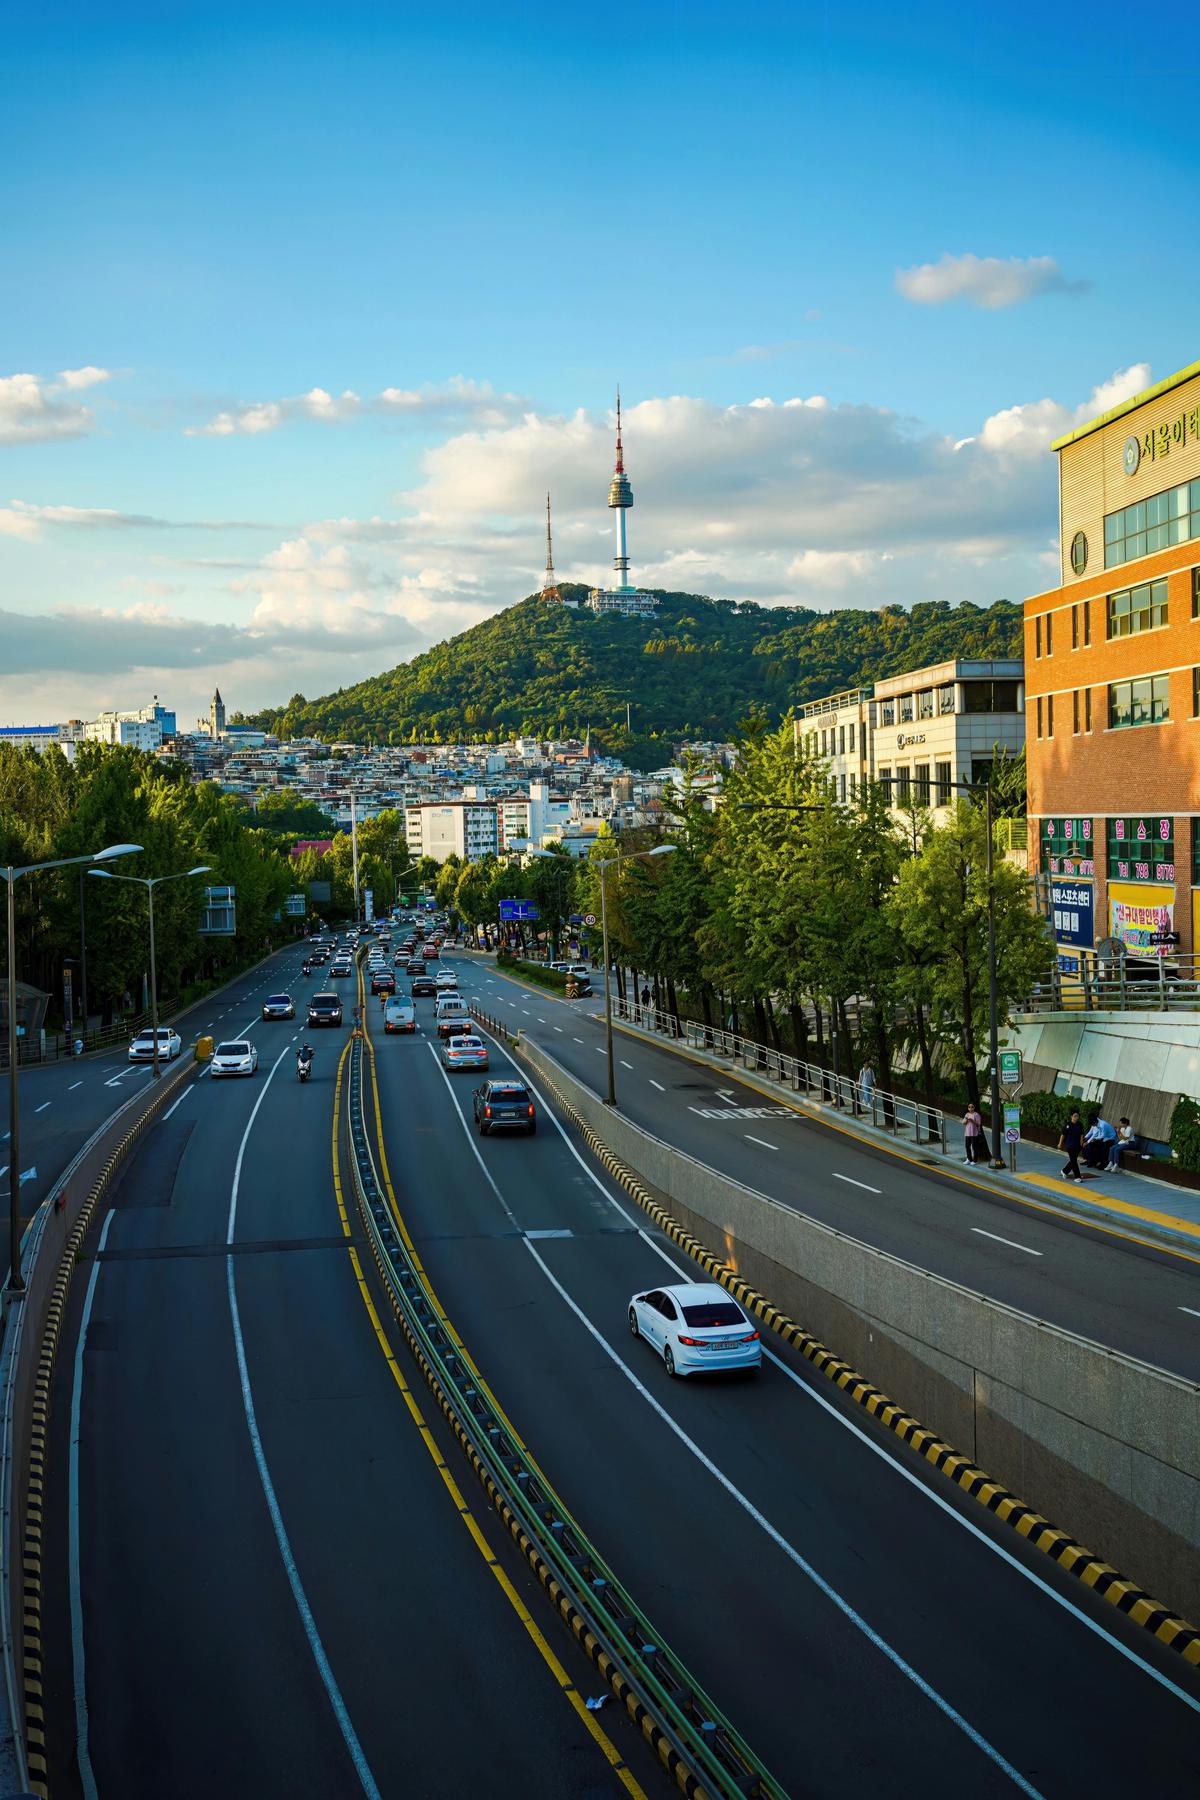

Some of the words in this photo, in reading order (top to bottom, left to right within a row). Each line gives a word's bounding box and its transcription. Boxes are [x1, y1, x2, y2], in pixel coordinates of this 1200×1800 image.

[1047, 820, 1091, 839] 수영장
[1115, 819, 1170, 840] 헬스장
[1117, 861, 1129, 878] Tel
[1135, 862, 1149, 879] 798
[1156, 863, 1175, 881] 9779
